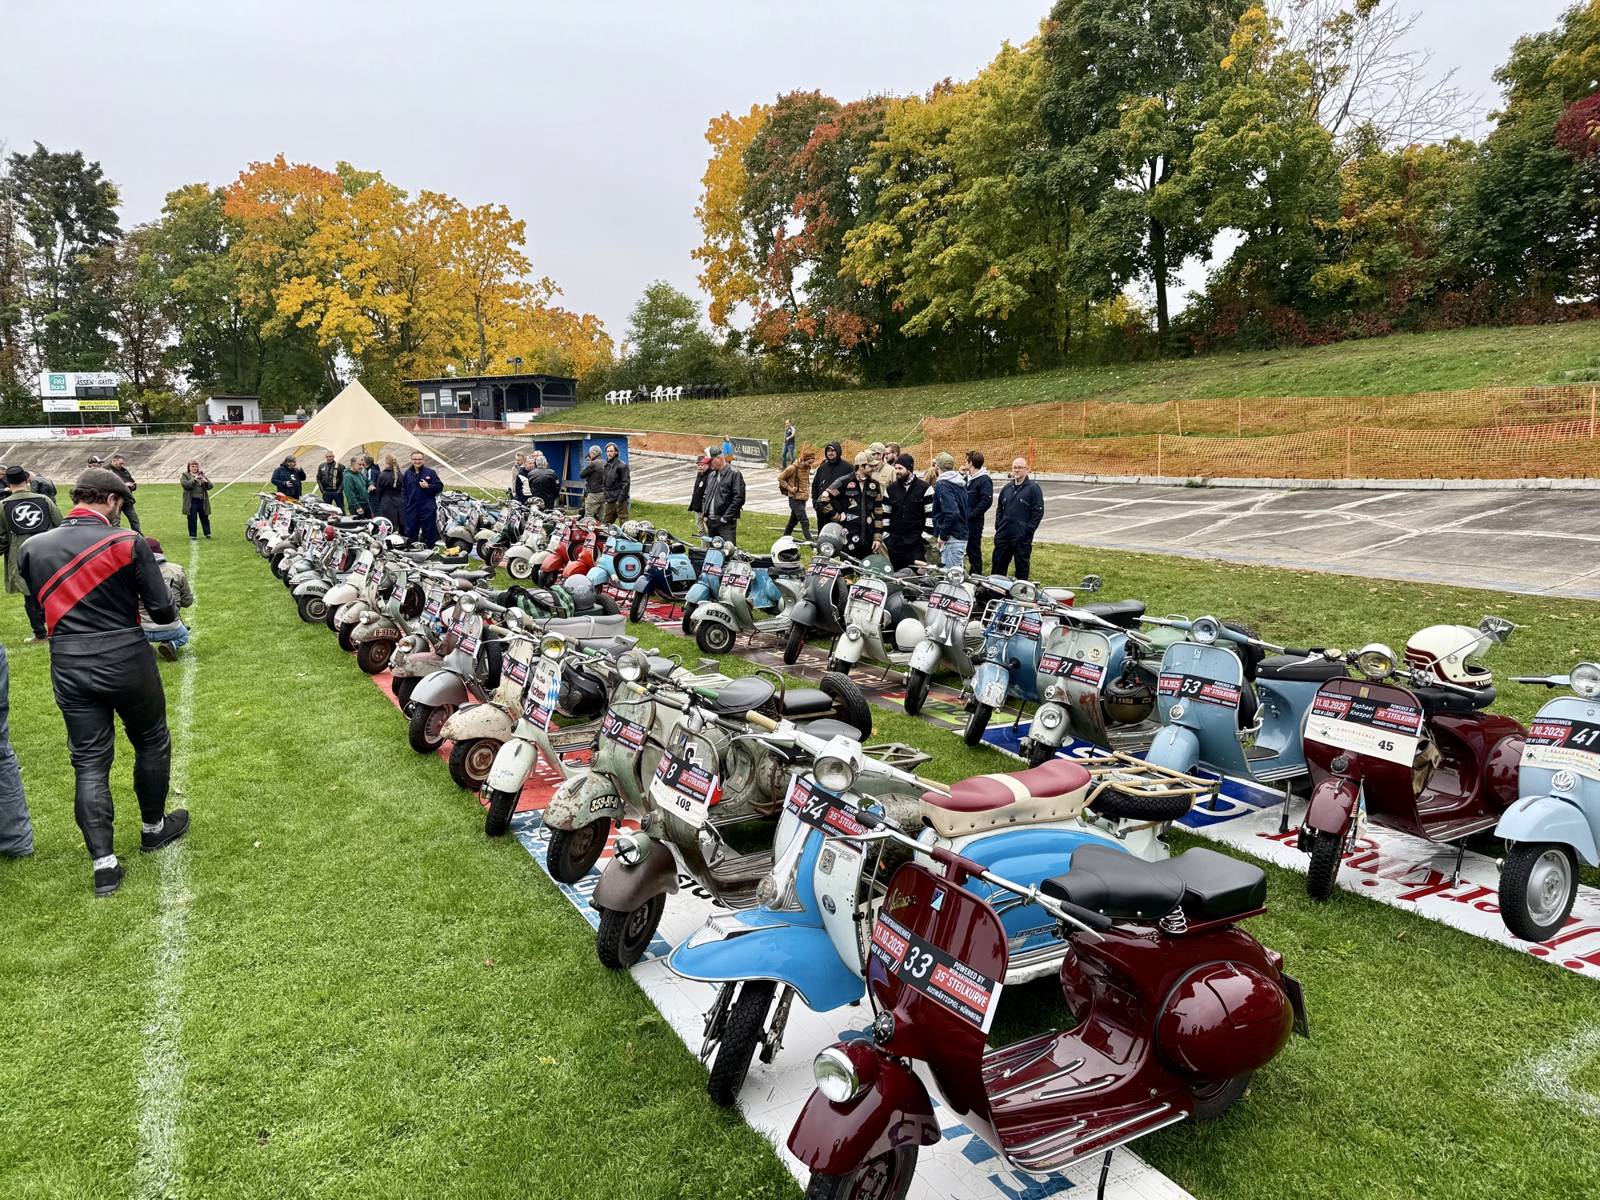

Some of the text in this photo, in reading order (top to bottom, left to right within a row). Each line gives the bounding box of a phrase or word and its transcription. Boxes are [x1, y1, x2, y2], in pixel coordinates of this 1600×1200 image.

[1058, 661, 1073, 674] 21
[1181, 679, 1202, 694] 53
[1314, 698, 1348, 711] 11.10.2025
[1377, 740, 1394, 751] 45
[1571, 728, 1600, 746] 41
[675, 795, 692, 812] 108
[802, 795, 829, 820] 54
[875, 925, 905, 956] 11.10.2025
[880, 950, 891, 965] LÄNGE
[903, 946, 934, 978] 33
[953, 961, 979, 979] POWERED
[947, 976, 988, 1007] STEILKURVE
